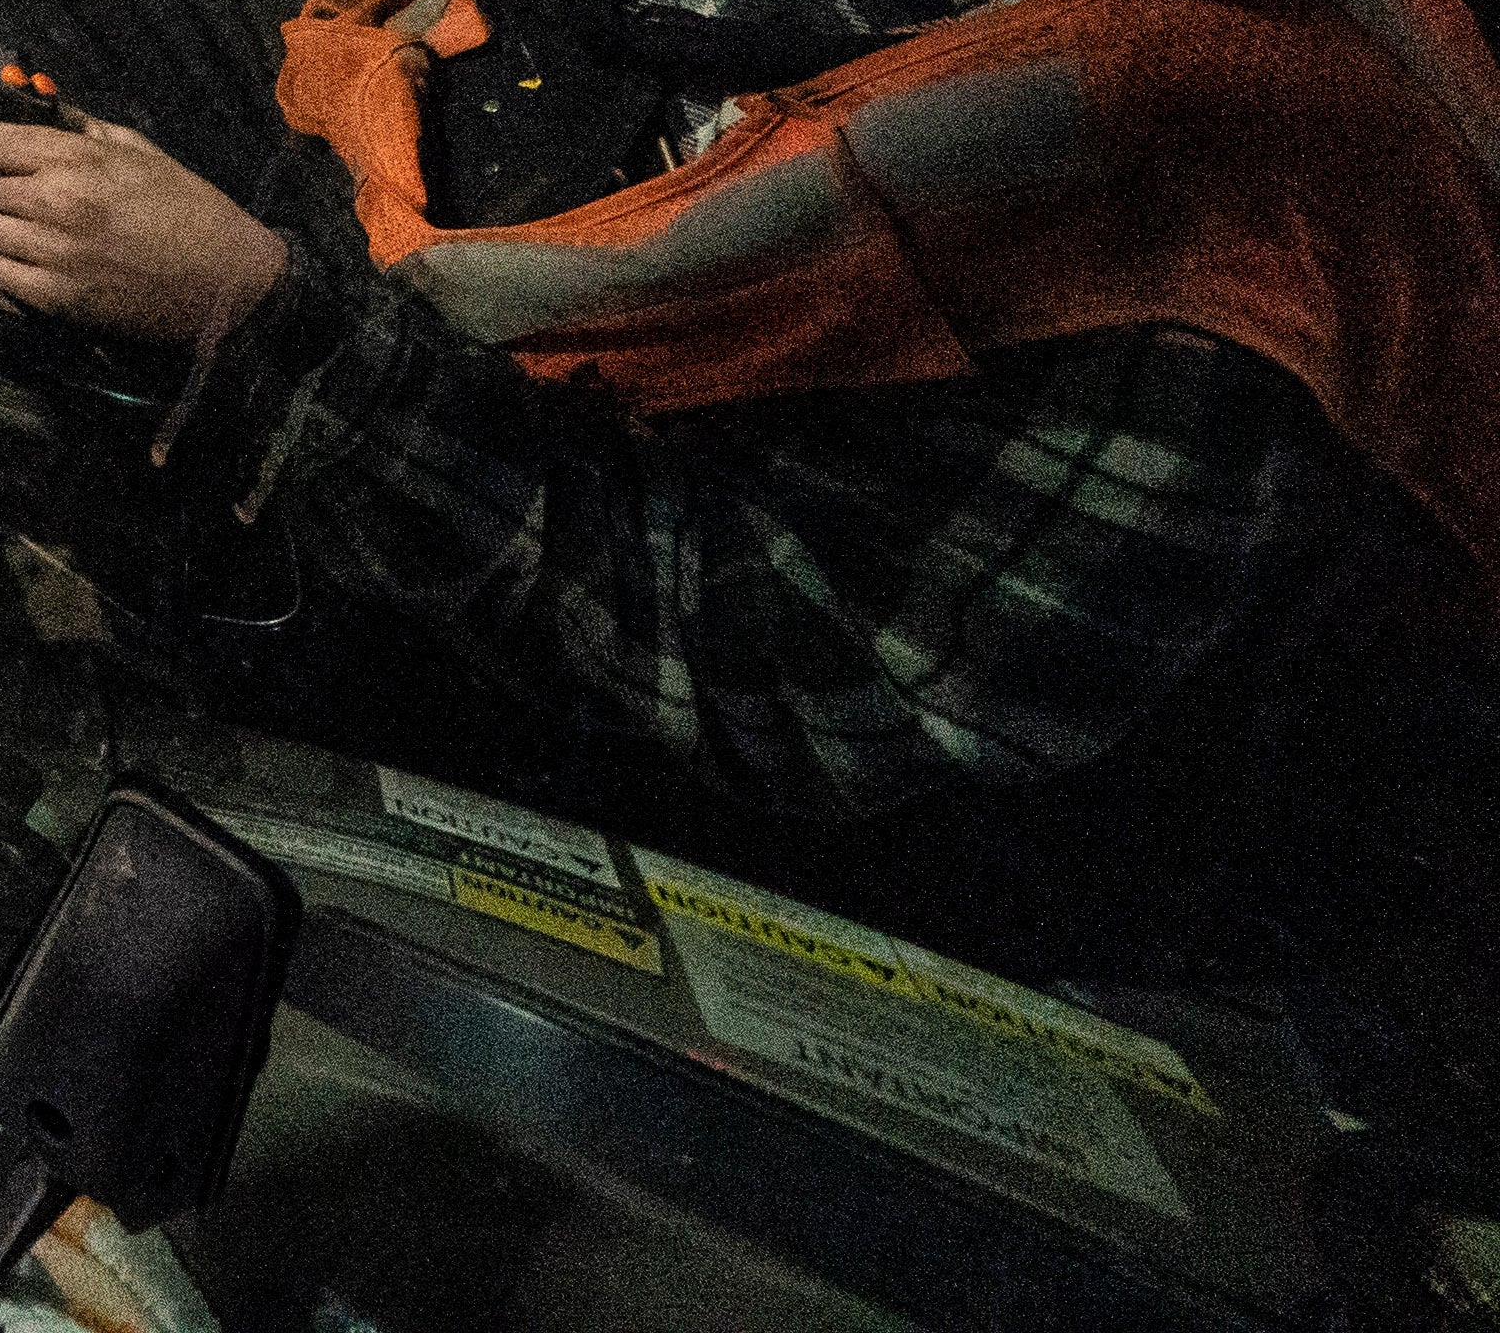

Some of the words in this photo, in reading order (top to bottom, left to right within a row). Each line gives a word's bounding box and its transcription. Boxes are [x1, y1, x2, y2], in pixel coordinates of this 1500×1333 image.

[396, 797, 559, 863] CAUTION
[459, 873, 606, 931] CAUTION
[659, 883, 854, 969] CAUTION
